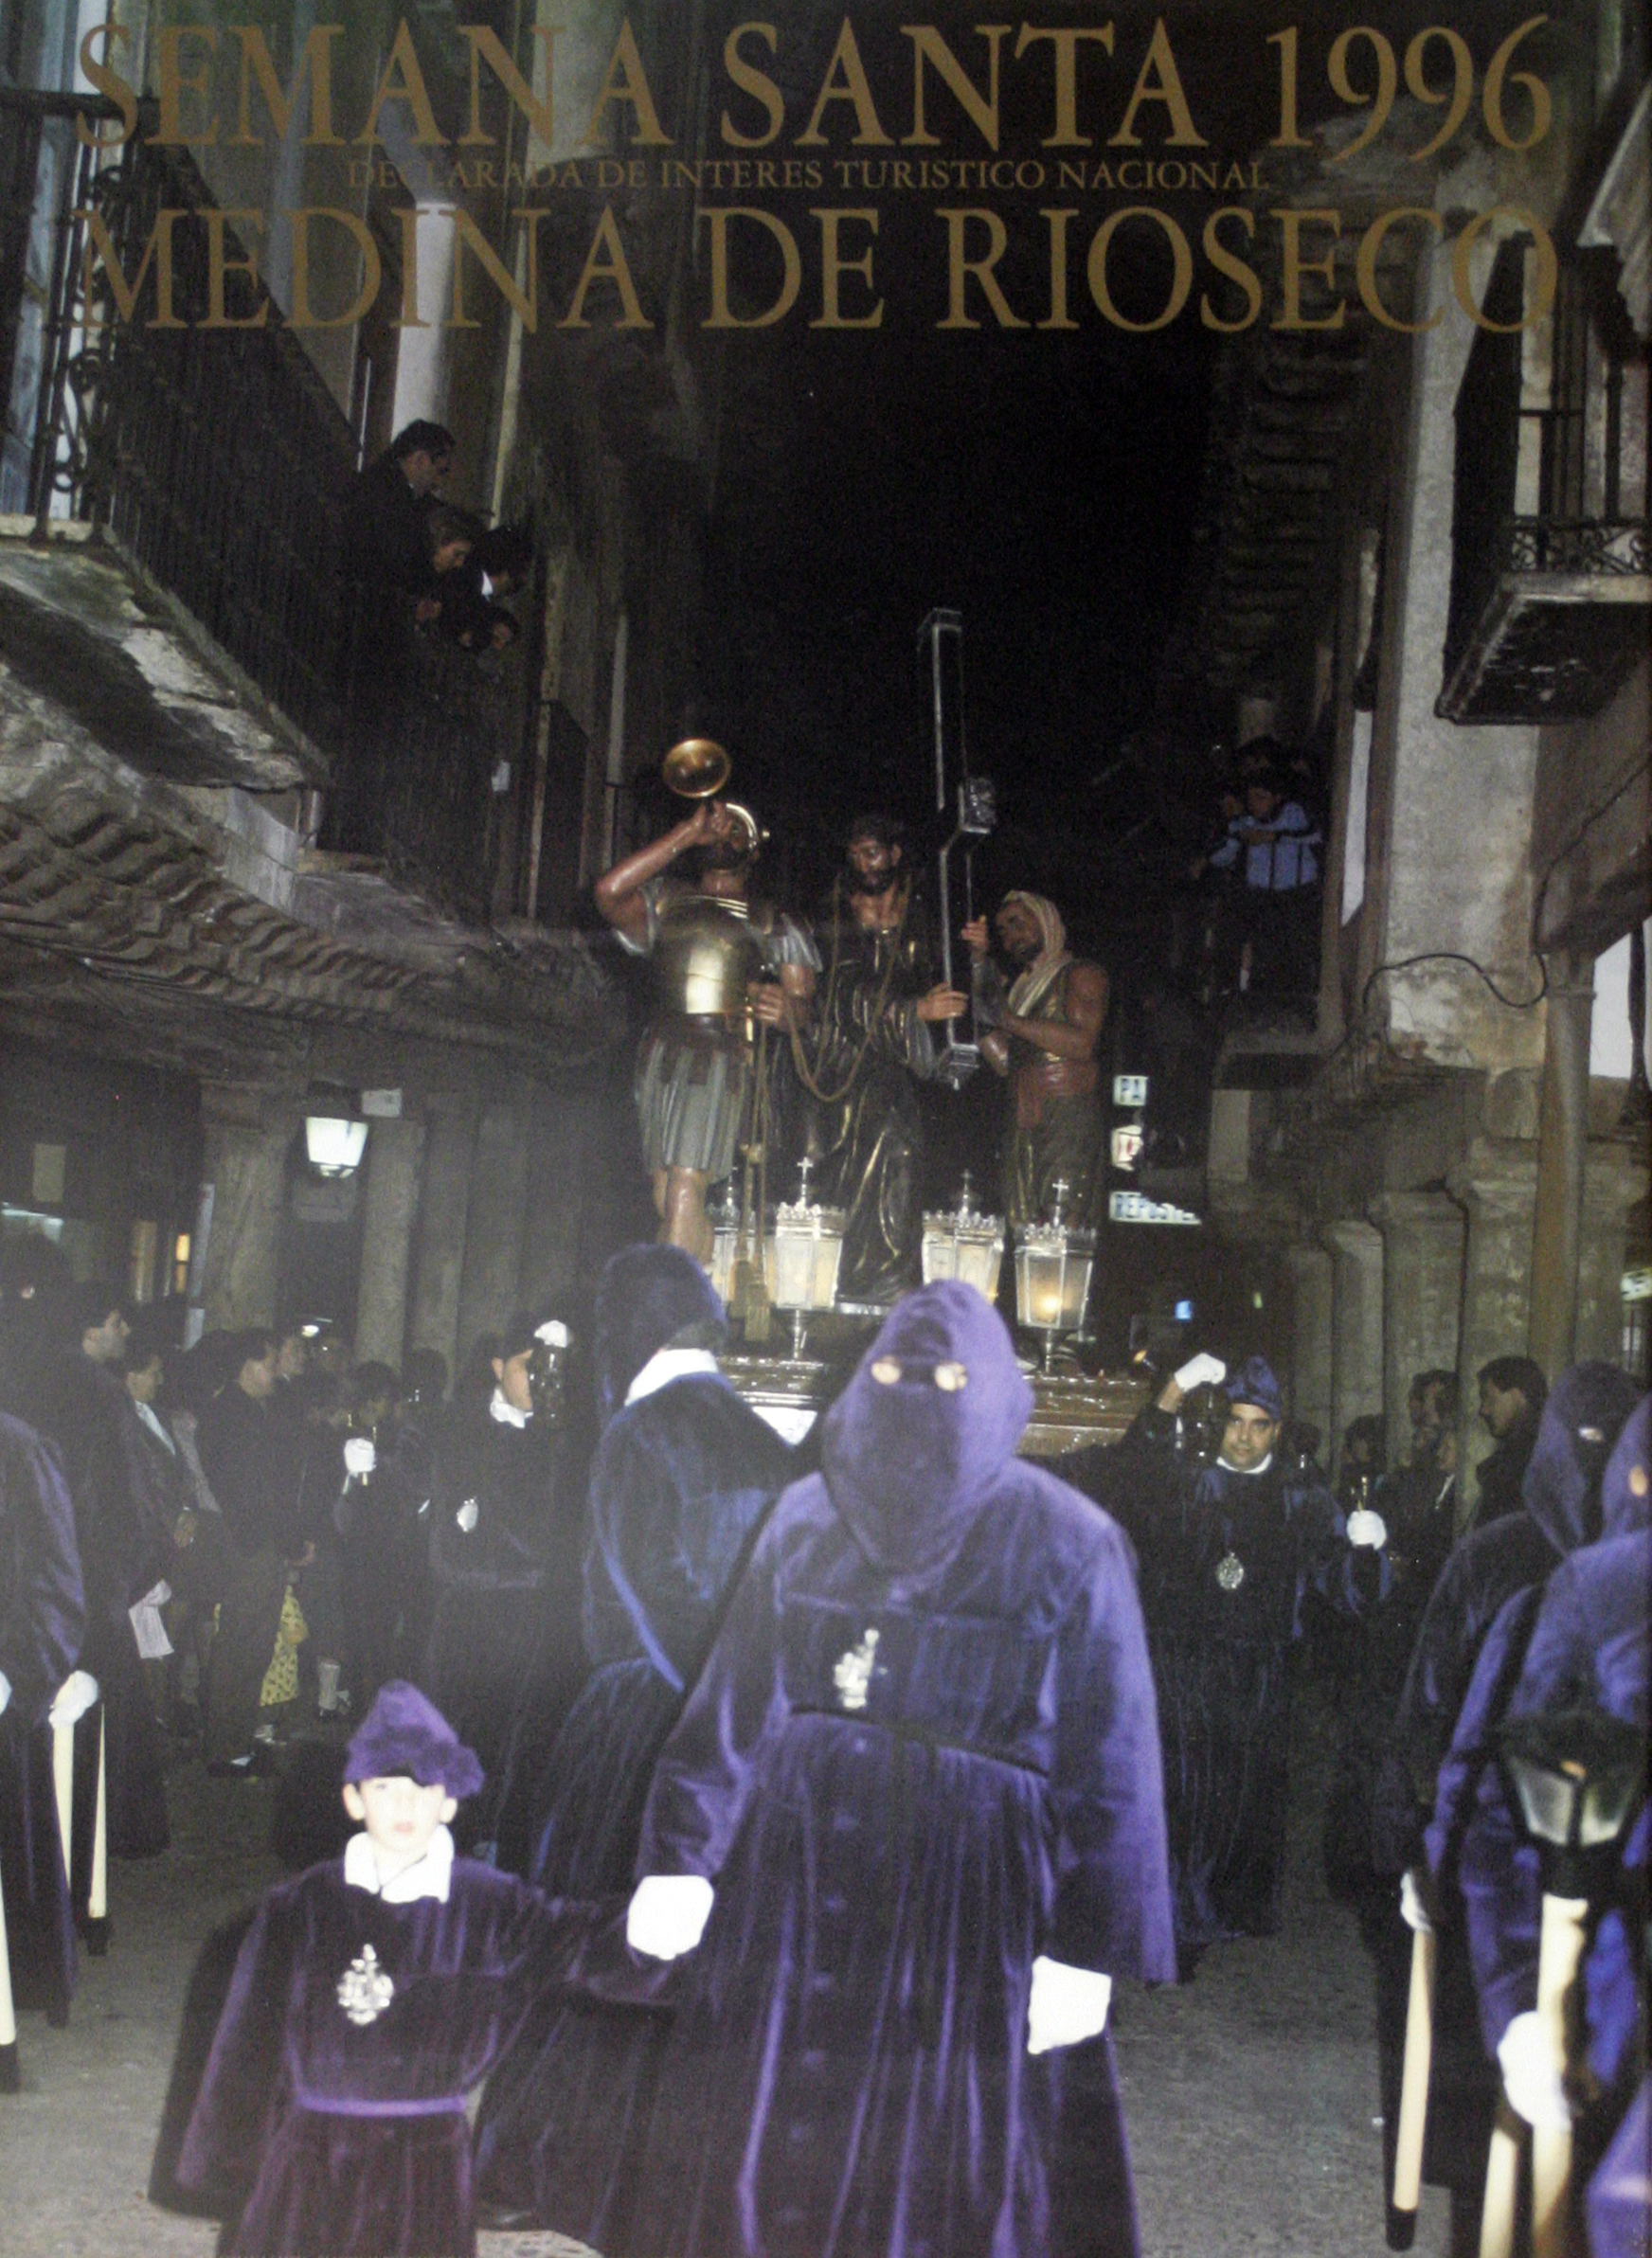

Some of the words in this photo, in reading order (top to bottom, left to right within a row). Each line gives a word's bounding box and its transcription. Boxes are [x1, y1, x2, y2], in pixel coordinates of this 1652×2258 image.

[76, 17, 675, 150] SEMANA
[721, 17, 1210, 152] SANTA
[1266, 14, 1553, 162] 1996
[349, 159, 584, 188] DECLARADA
[596, 159, 649, 188] DE
[661, 159, 823, 188] INTERES
[834, 159, 1045, 189] TURISTICO
[1057, 159, 1270, 189] NACIONAL
[72, 204, 655, 333] MEDINA
[697, 206, 885, 330] DE
[934, 205, 1558, 333] RIOSECO
